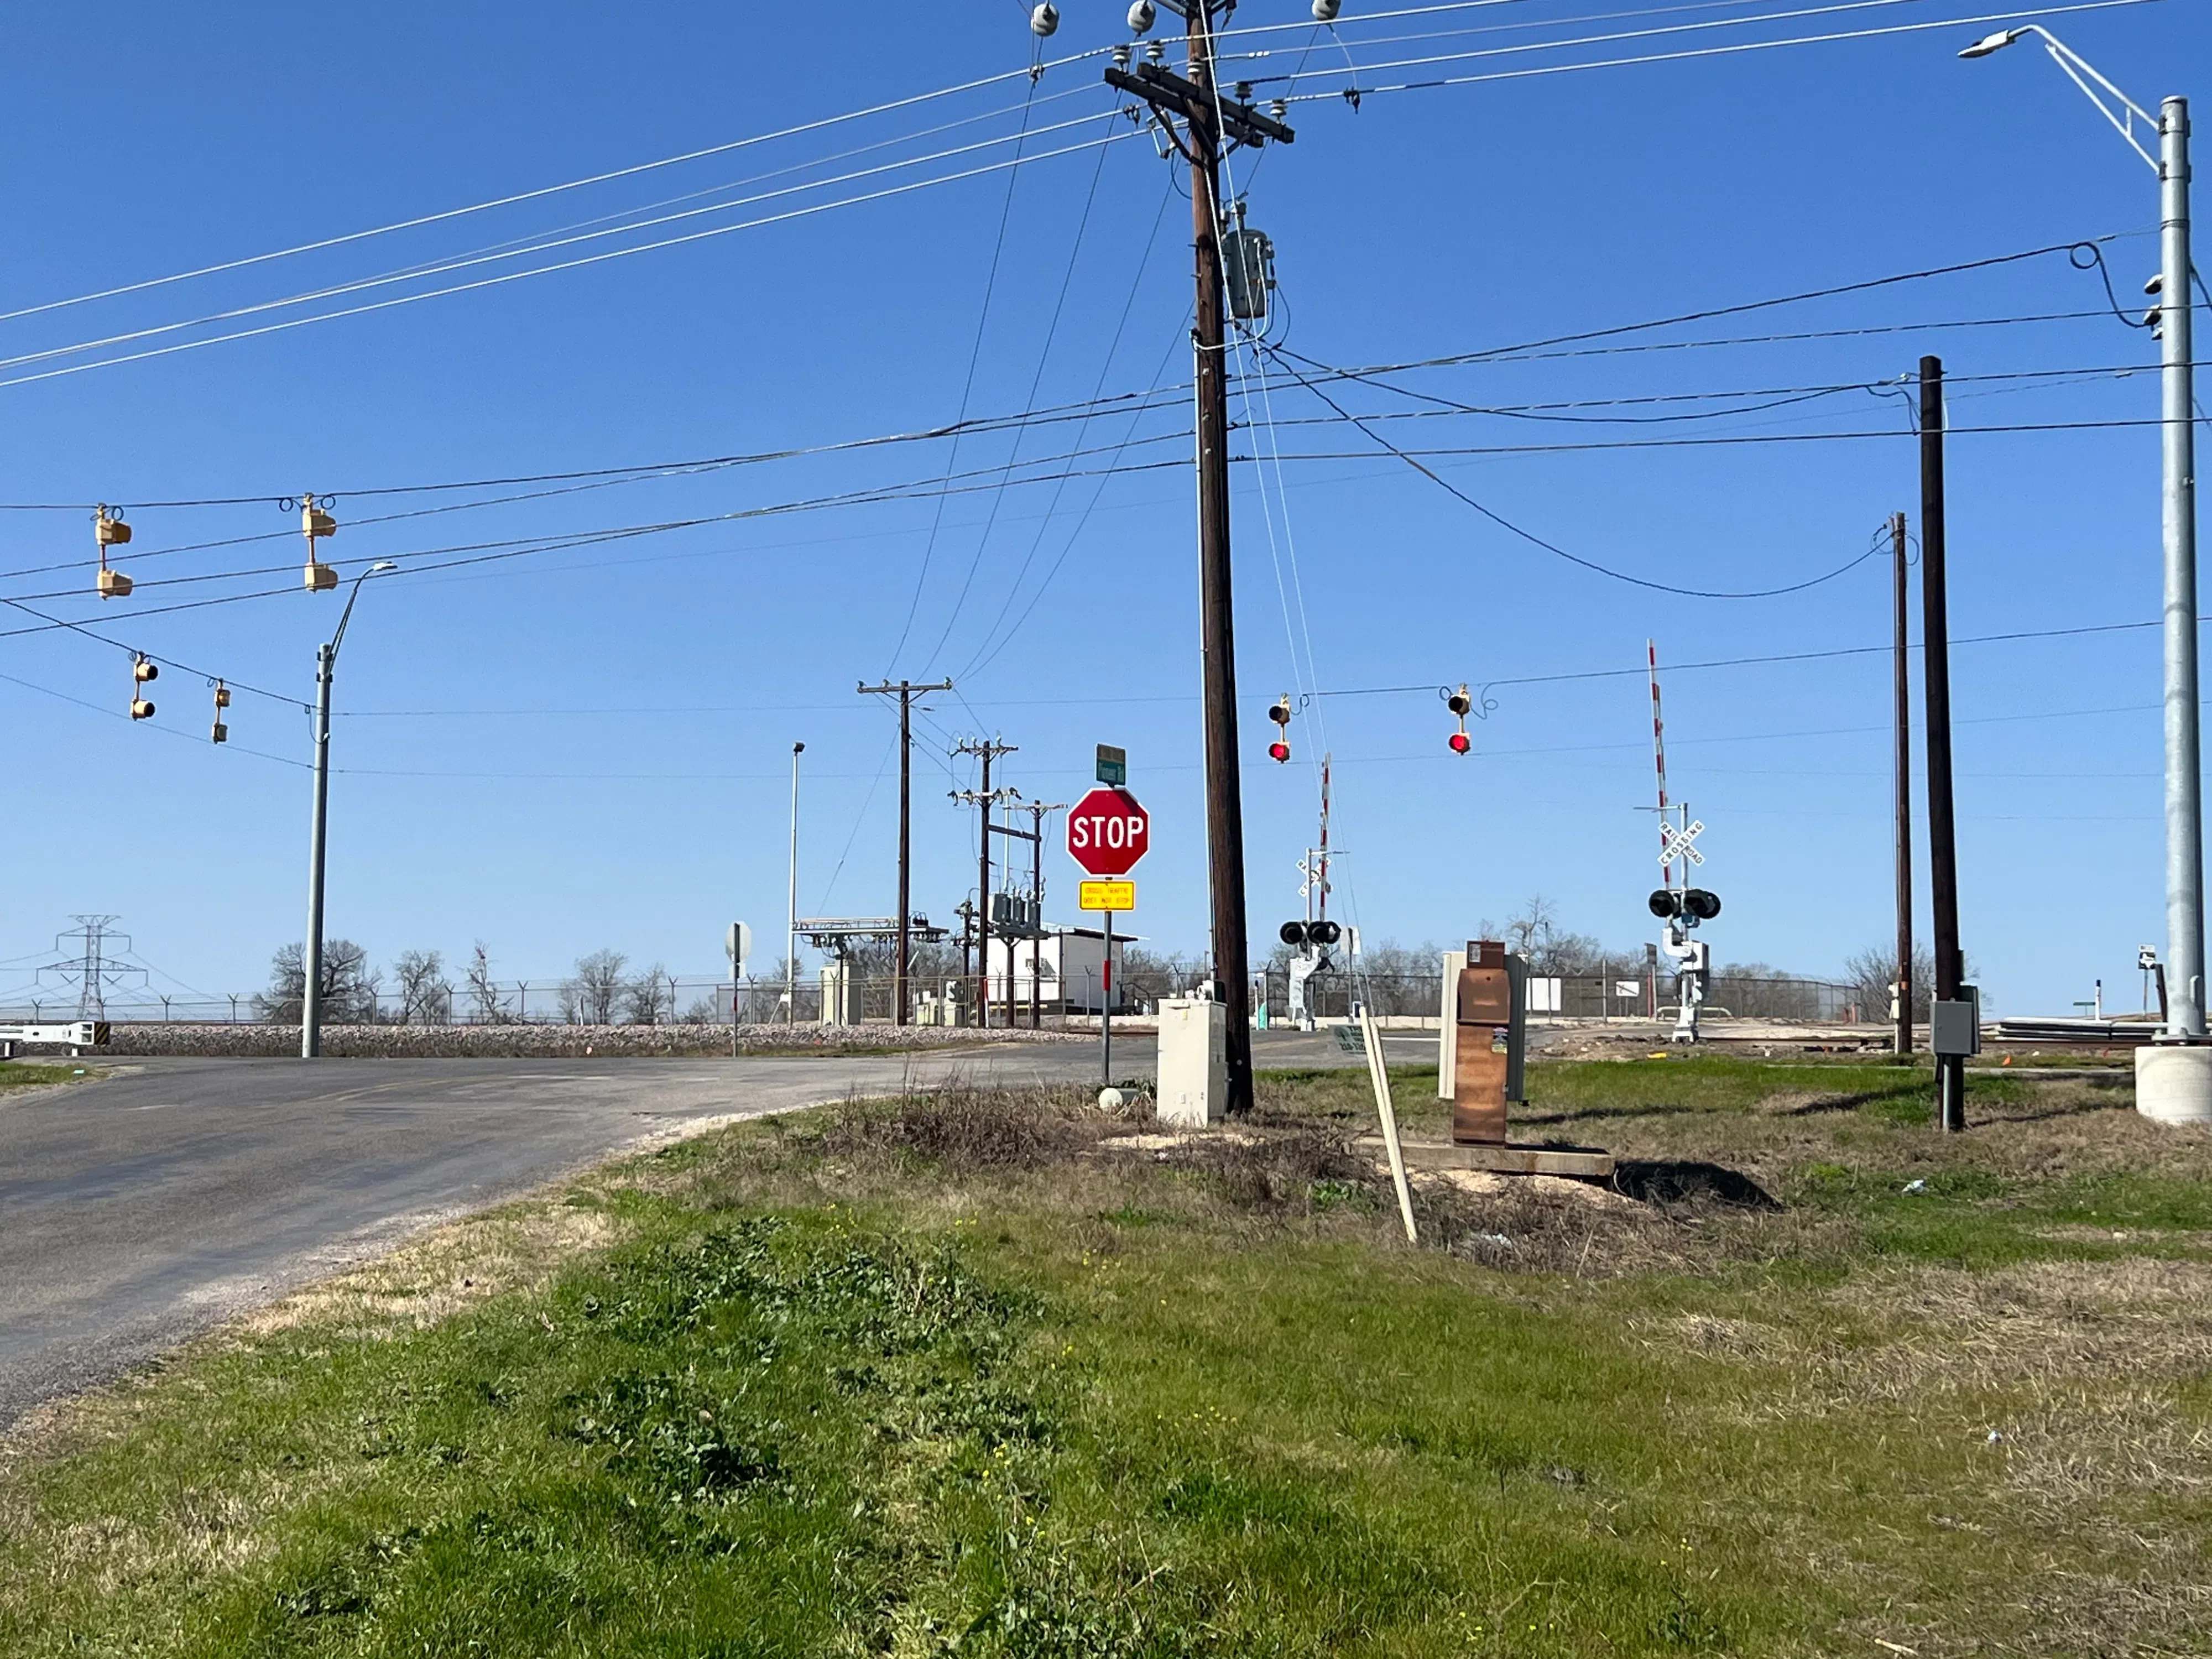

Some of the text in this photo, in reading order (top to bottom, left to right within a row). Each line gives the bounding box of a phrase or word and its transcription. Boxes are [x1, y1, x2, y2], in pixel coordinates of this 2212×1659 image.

[1073, 816, 1144, 848] STOP
[1661, 823, 1703, 864] CROSSING
[1661, 824, 1703, 864] RAIL ROAD
